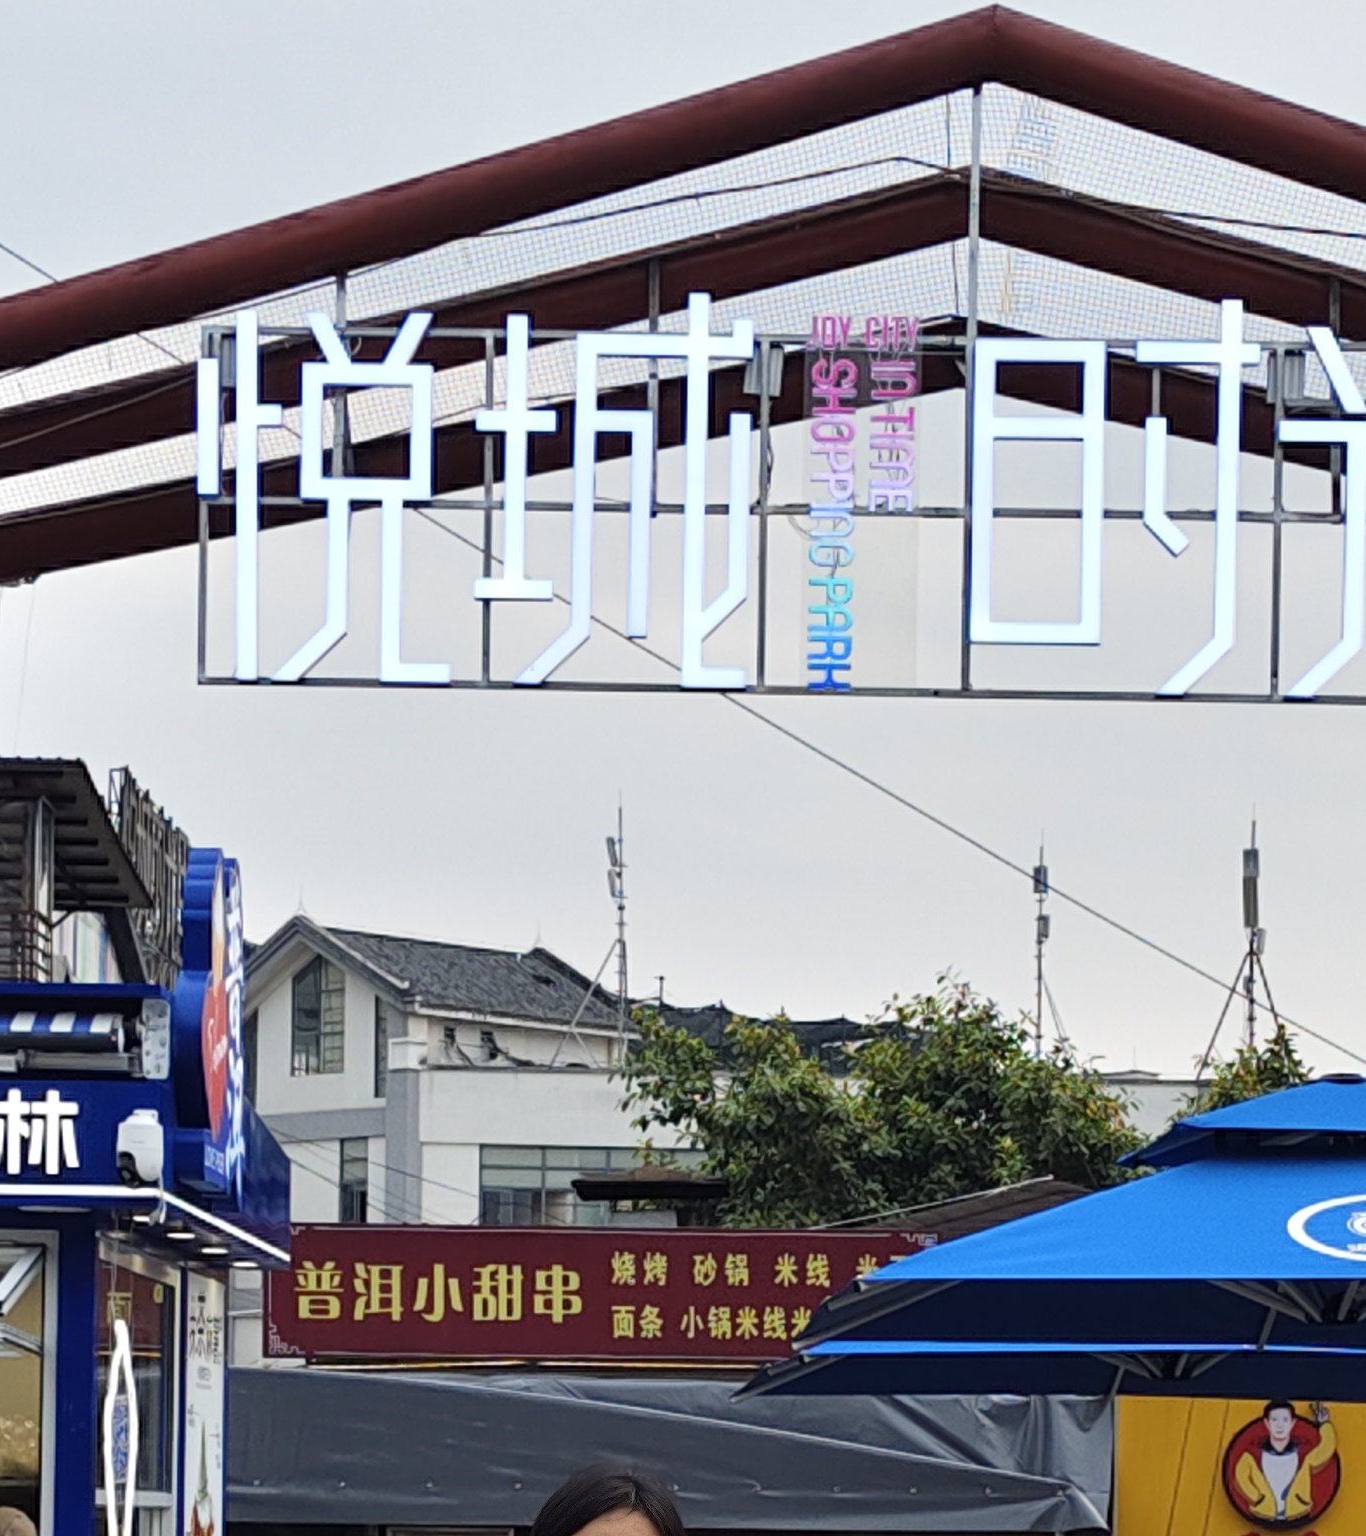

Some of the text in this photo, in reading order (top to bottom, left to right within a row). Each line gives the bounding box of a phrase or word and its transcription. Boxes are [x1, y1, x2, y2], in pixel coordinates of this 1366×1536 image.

[806, 316, 920, 351] JOY CITY
[869, 407, 915, 511] TIME
[197, 292, 754, 690] 悦城
[807, 357, 859, 691] SHOPPING PARK
[294, 1261, 583, 1324] 普洱小甜串
[611, 1251, 668, 1287] 烧烤
[693, 1253, 750, 1288] 砂锅
[774, 1252, 831, 1288] 米线
[611, 1304, 664, 1340] 面条
